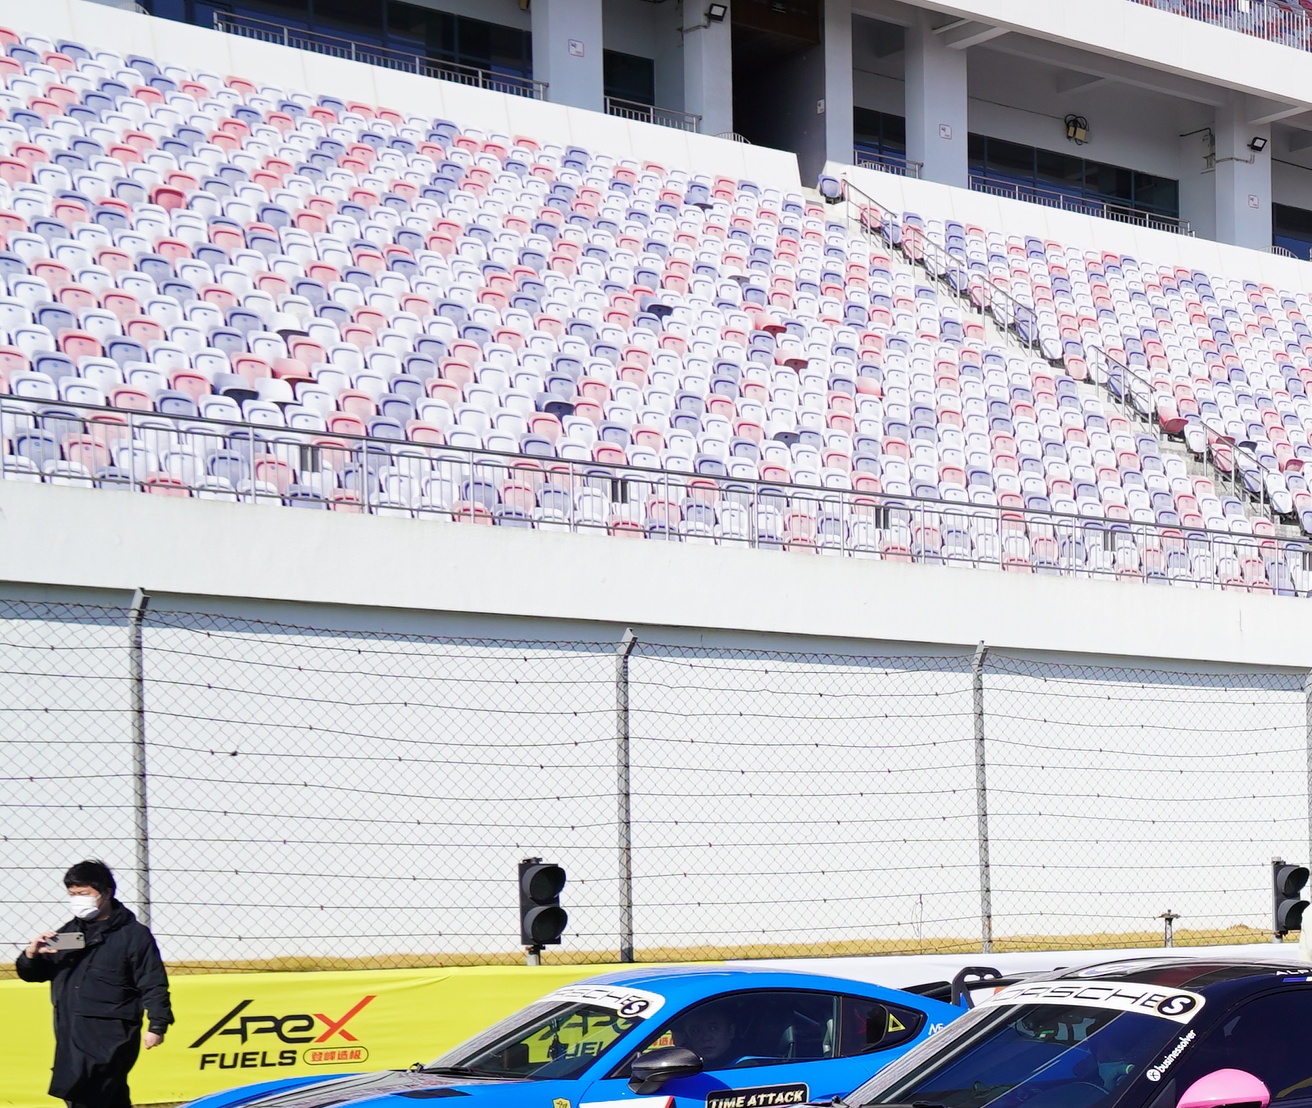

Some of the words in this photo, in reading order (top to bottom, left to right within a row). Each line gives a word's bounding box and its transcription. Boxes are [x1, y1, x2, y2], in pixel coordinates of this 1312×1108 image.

[623, 1000, 649, 1015] S
[1162, 997, 1192, 1015] S
[199, 1050, 298, 1070] FUELS
[1156, 1029, 1198, 1074] businessolver
[748, 1090, 805, 1108] ATTACK
